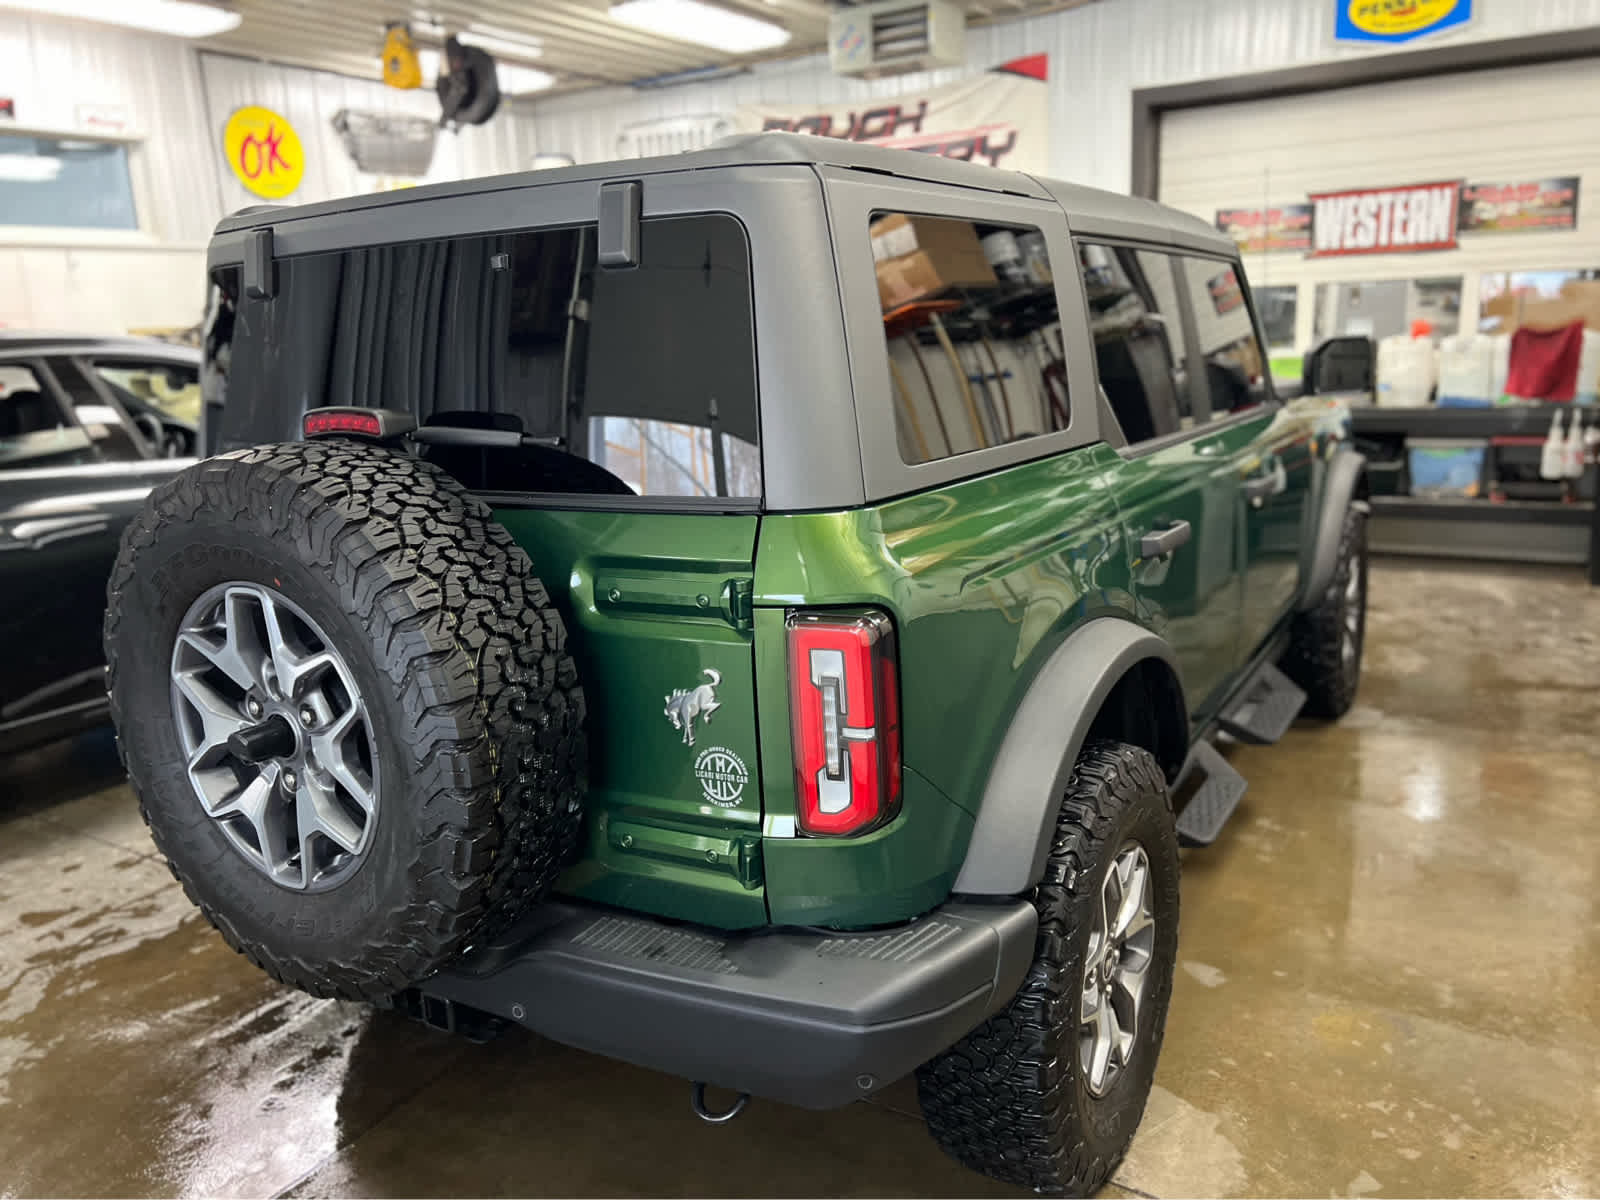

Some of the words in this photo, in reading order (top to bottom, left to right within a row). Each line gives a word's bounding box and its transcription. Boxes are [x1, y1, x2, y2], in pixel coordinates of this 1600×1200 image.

[240, 124, 292, 180] OK
[1315, 187, 1453, 250] WESTERN
[715, 772, 735, 782] MOTOR
[736, 775, 749, 784] CAR
